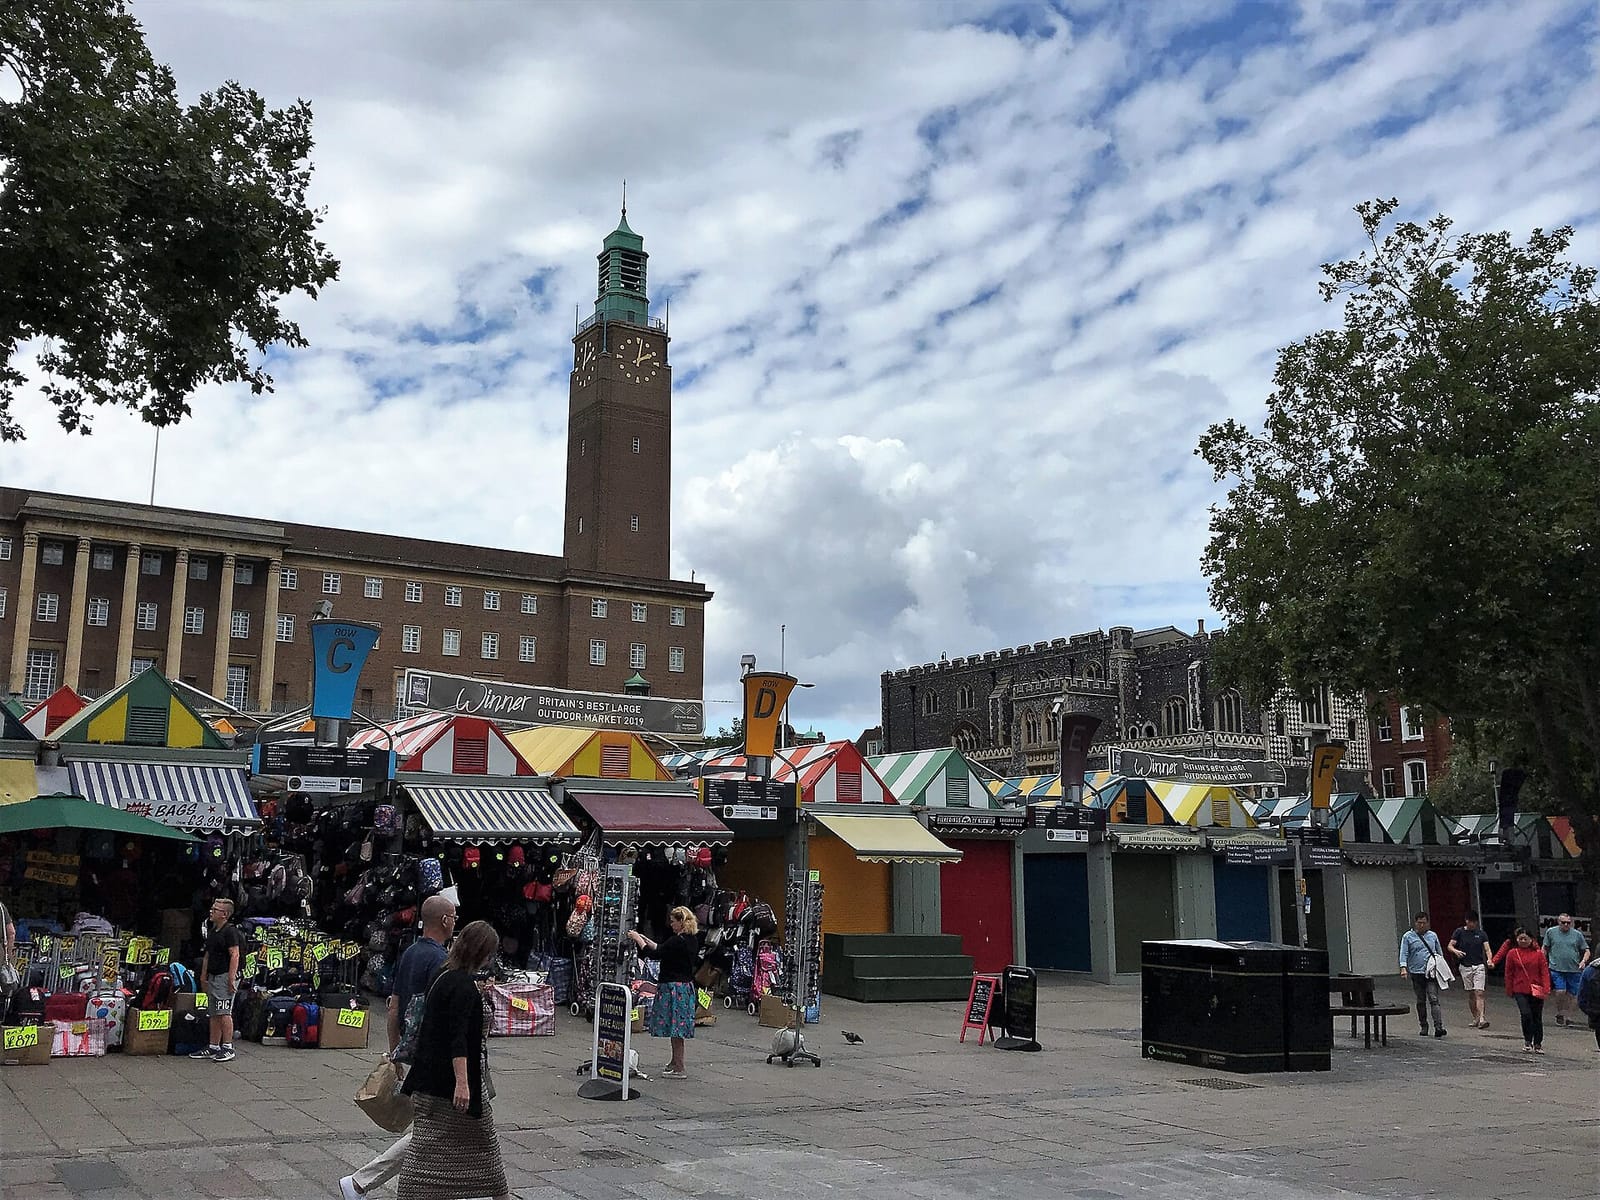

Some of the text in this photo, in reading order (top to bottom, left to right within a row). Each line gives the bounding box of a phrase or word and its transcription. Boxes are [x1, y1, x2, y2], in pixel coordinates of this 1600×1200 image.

[334, 628, 357, 638] ROW
[327, 638, 356, 673] C
[456, 684, 533, 714] Winner
[538, 696, 642, 714] BRITAIN'S BEST LARGE
[753, 687, 777, 719] D
[537, 708, 644, 727] OUTDOOR MARKET 2019
[1134, 755, 1178, 777] Winner
[1210, 764, 1225, 773] BEST
[1227, 764, 1246, 772] LARGE
[1318, 754, 1334, 778] F
[1184, 772, 1214, 780] OUTDOOR
[155, 803, 198, 817] BAGS
[187, 814, 223, 827] £3.99
[269, 953, 281, 968] 15
[216, 999, 230, 1011] PIC
[602, 1003, 624, 1016] INDIAN
[600, 1018, 611, 1029] TAKE
